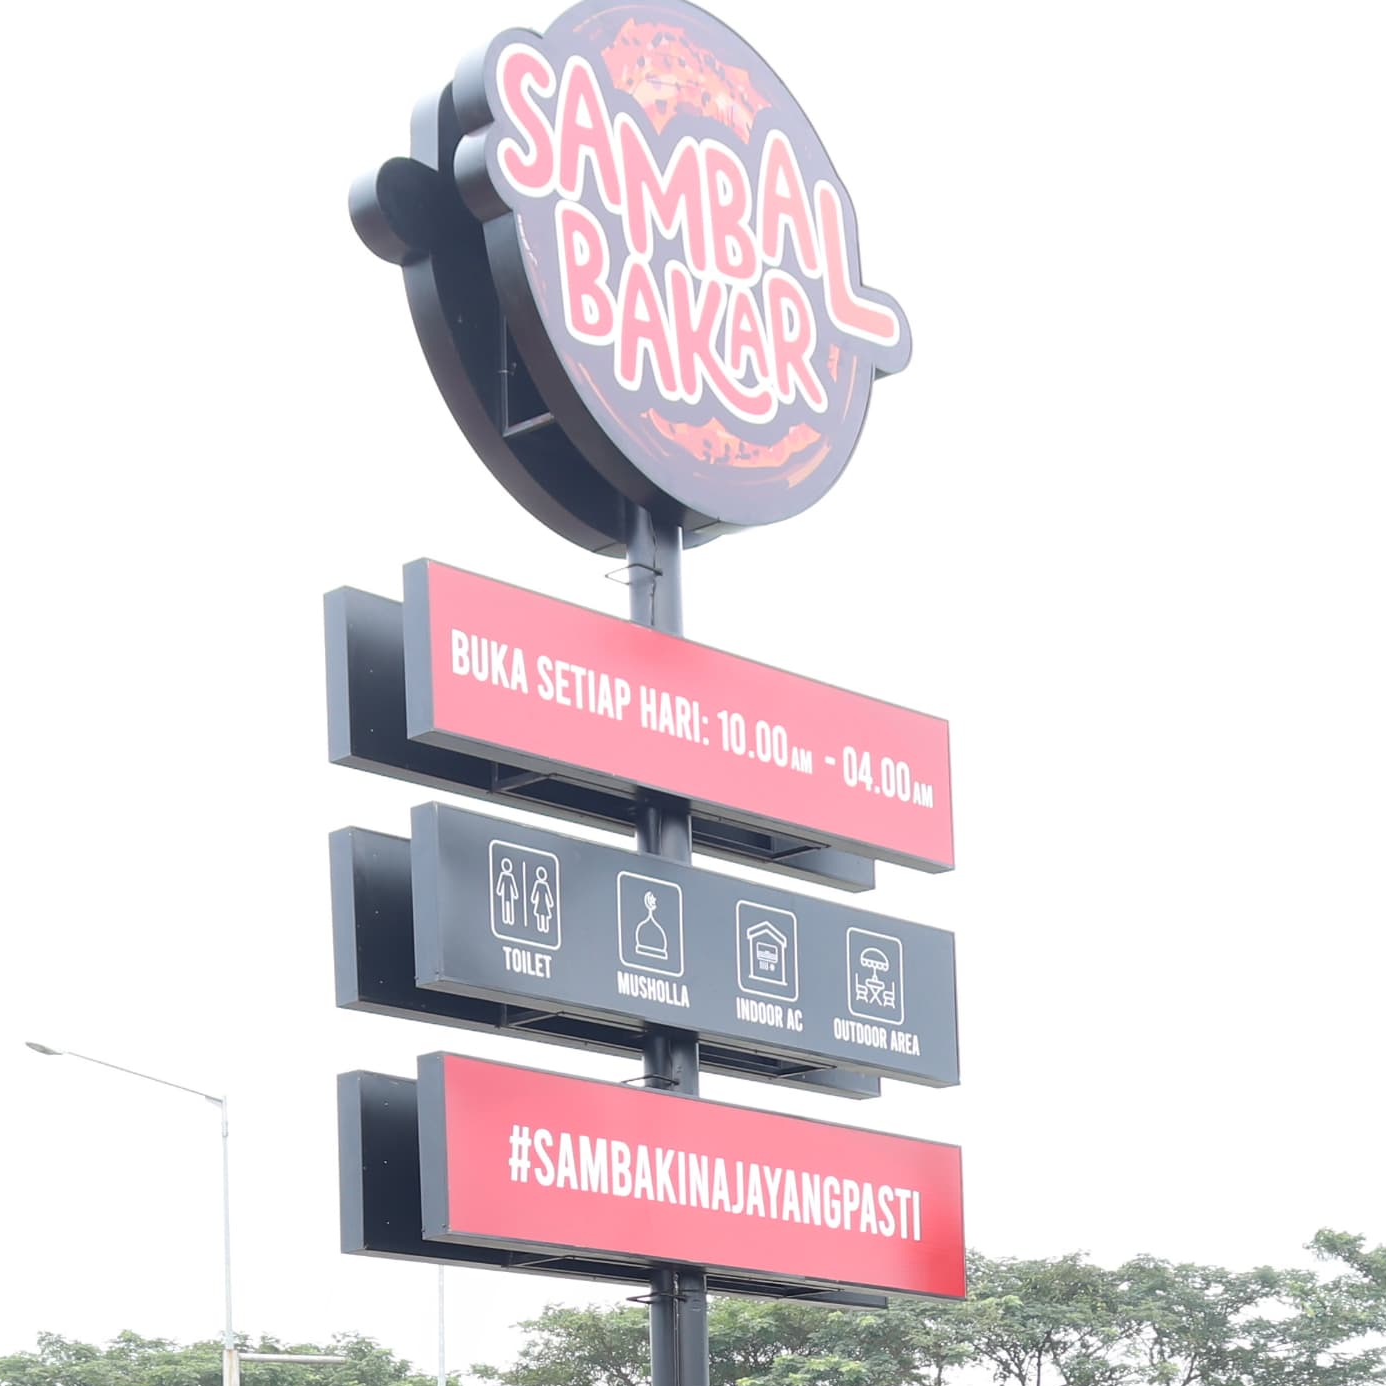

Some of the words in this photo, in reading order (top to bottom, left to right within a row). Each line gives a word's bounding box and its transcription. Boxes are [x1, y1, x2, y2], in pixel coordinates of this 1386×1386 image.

[496, 44, 900, 346] SAMBAL
[557, 199, 827, 423] BAKAR
[451, 628, 529, 694] BUKA
[536, 655, 631, 721] SETIAP
[640, 685, 710, 746] HARI:
[503, 946, 552, 979] TOILET
[617, 971, 690, 1009] MUSHOLLA
[736, 998, 783, 1028] INDOOR
[786, 1009, 804, 1032] AC
[833, 1018, 888, 1050] OUTDOOR
[889, 1034, 921, 1057] AREA
[509, 1125, 923, 1241] #SAMBAKINAJAYANGPASTI
